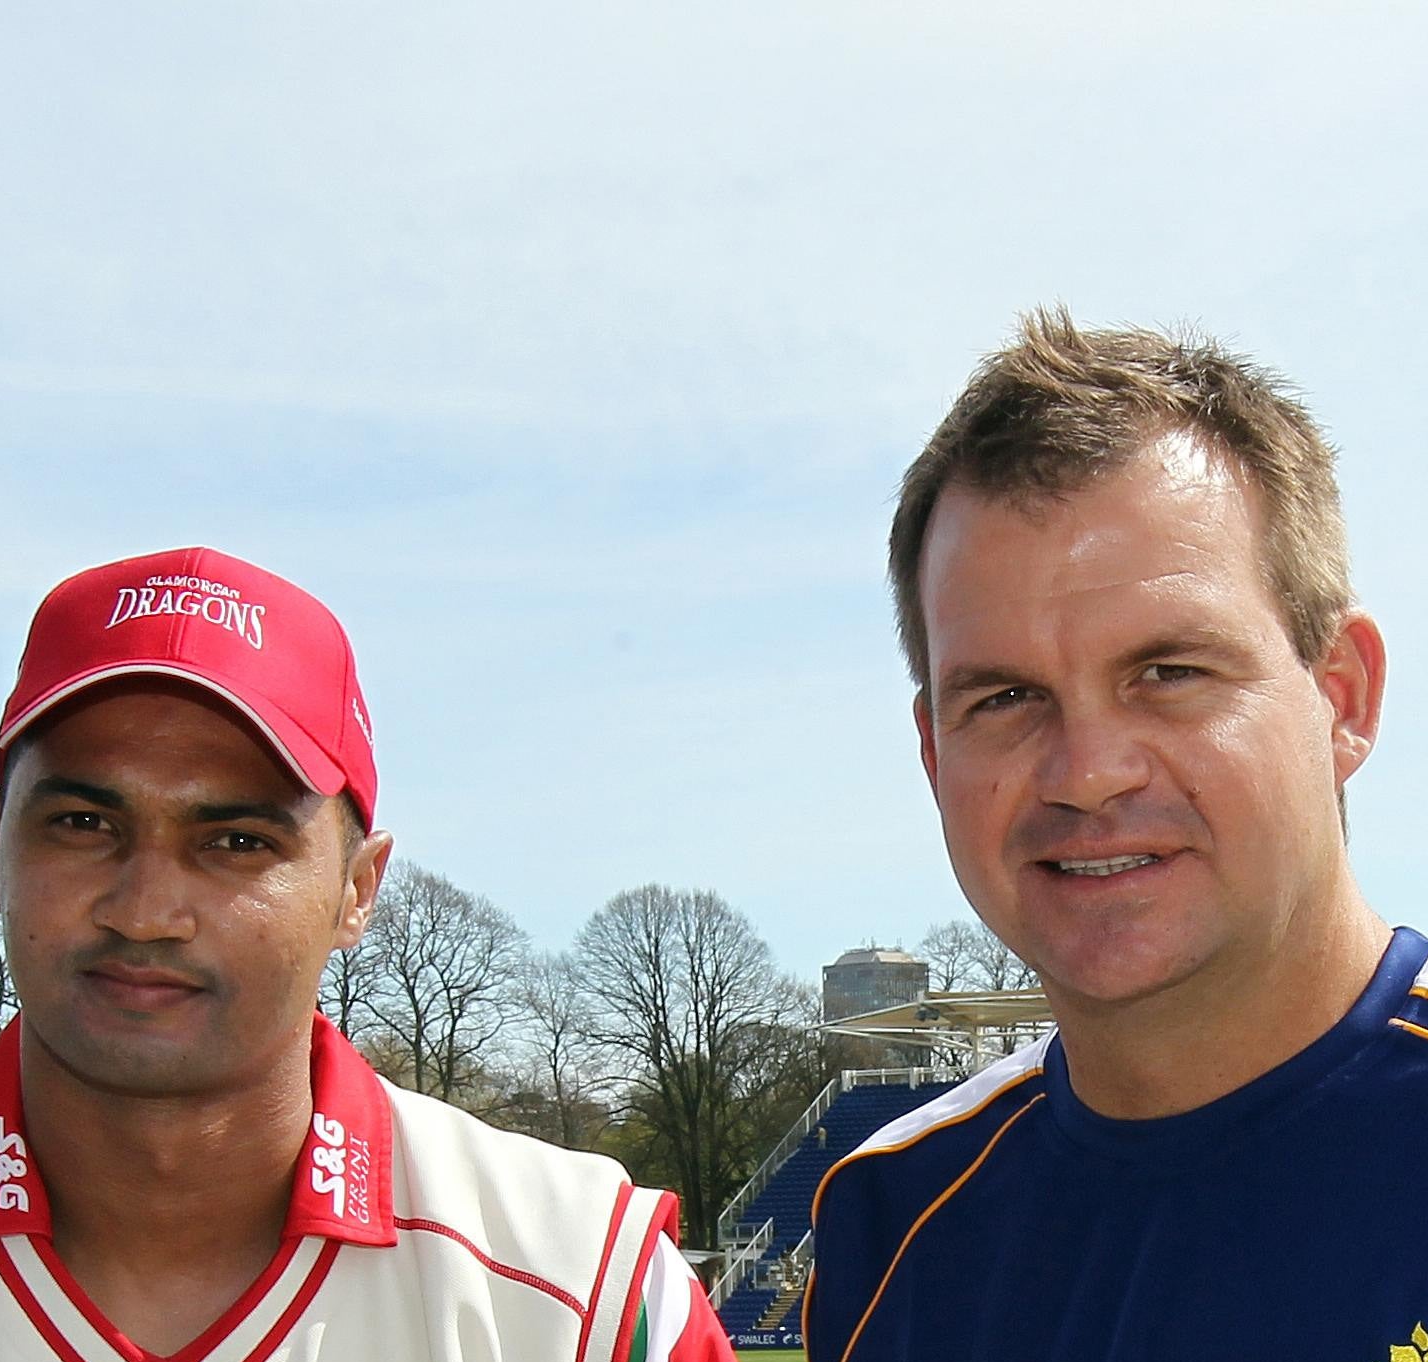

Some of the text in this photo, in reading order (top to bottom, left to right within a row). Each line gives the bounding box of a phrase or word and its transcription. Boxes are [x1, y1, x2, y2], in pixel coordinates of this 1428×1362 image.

[105, 588, 266, 650] DRAGONS
[146, 575, 241, 599] GLAMORGAN
[312, 1112, 346, 1219] S&G
[348, 1132, 362, 1217] PRINT
[358, 1141, 371, 1224] GROUP
[737, 1334, 776, 1345] SWALEC
